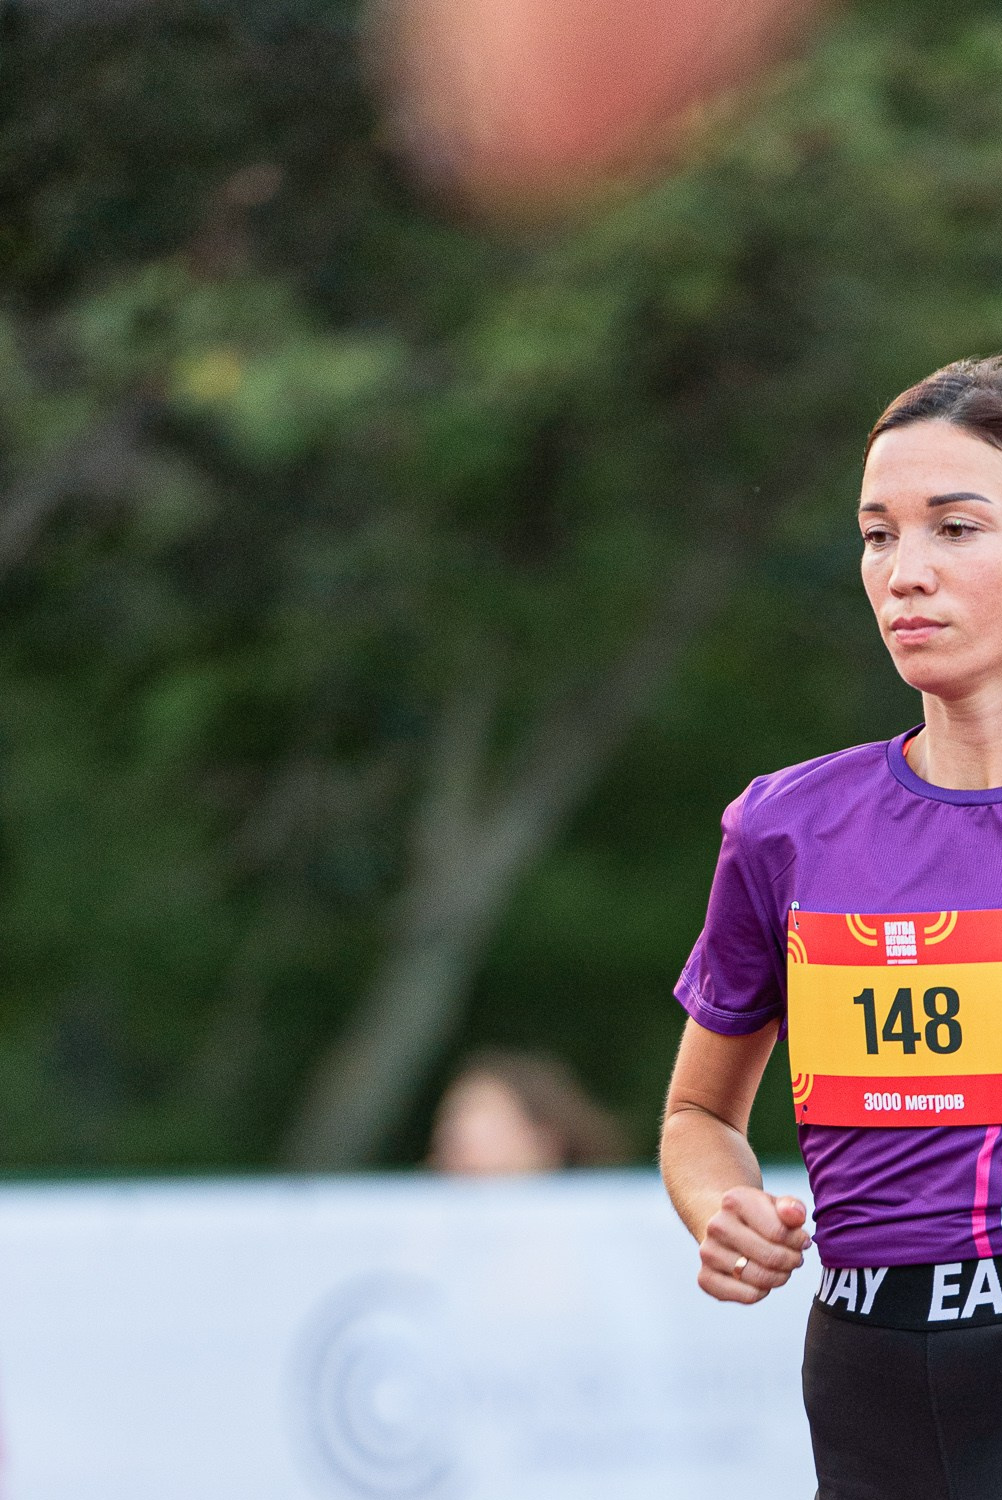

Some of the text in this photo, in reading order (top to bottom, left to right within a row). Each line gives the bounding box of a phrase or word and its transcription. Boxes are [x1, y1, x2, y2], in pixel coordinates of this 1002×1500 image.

[884, 921, 916, 936] БИТВА
[853, 986, 963, 1055] 148
[863, 1092, 965, 1114] 3000 метров
